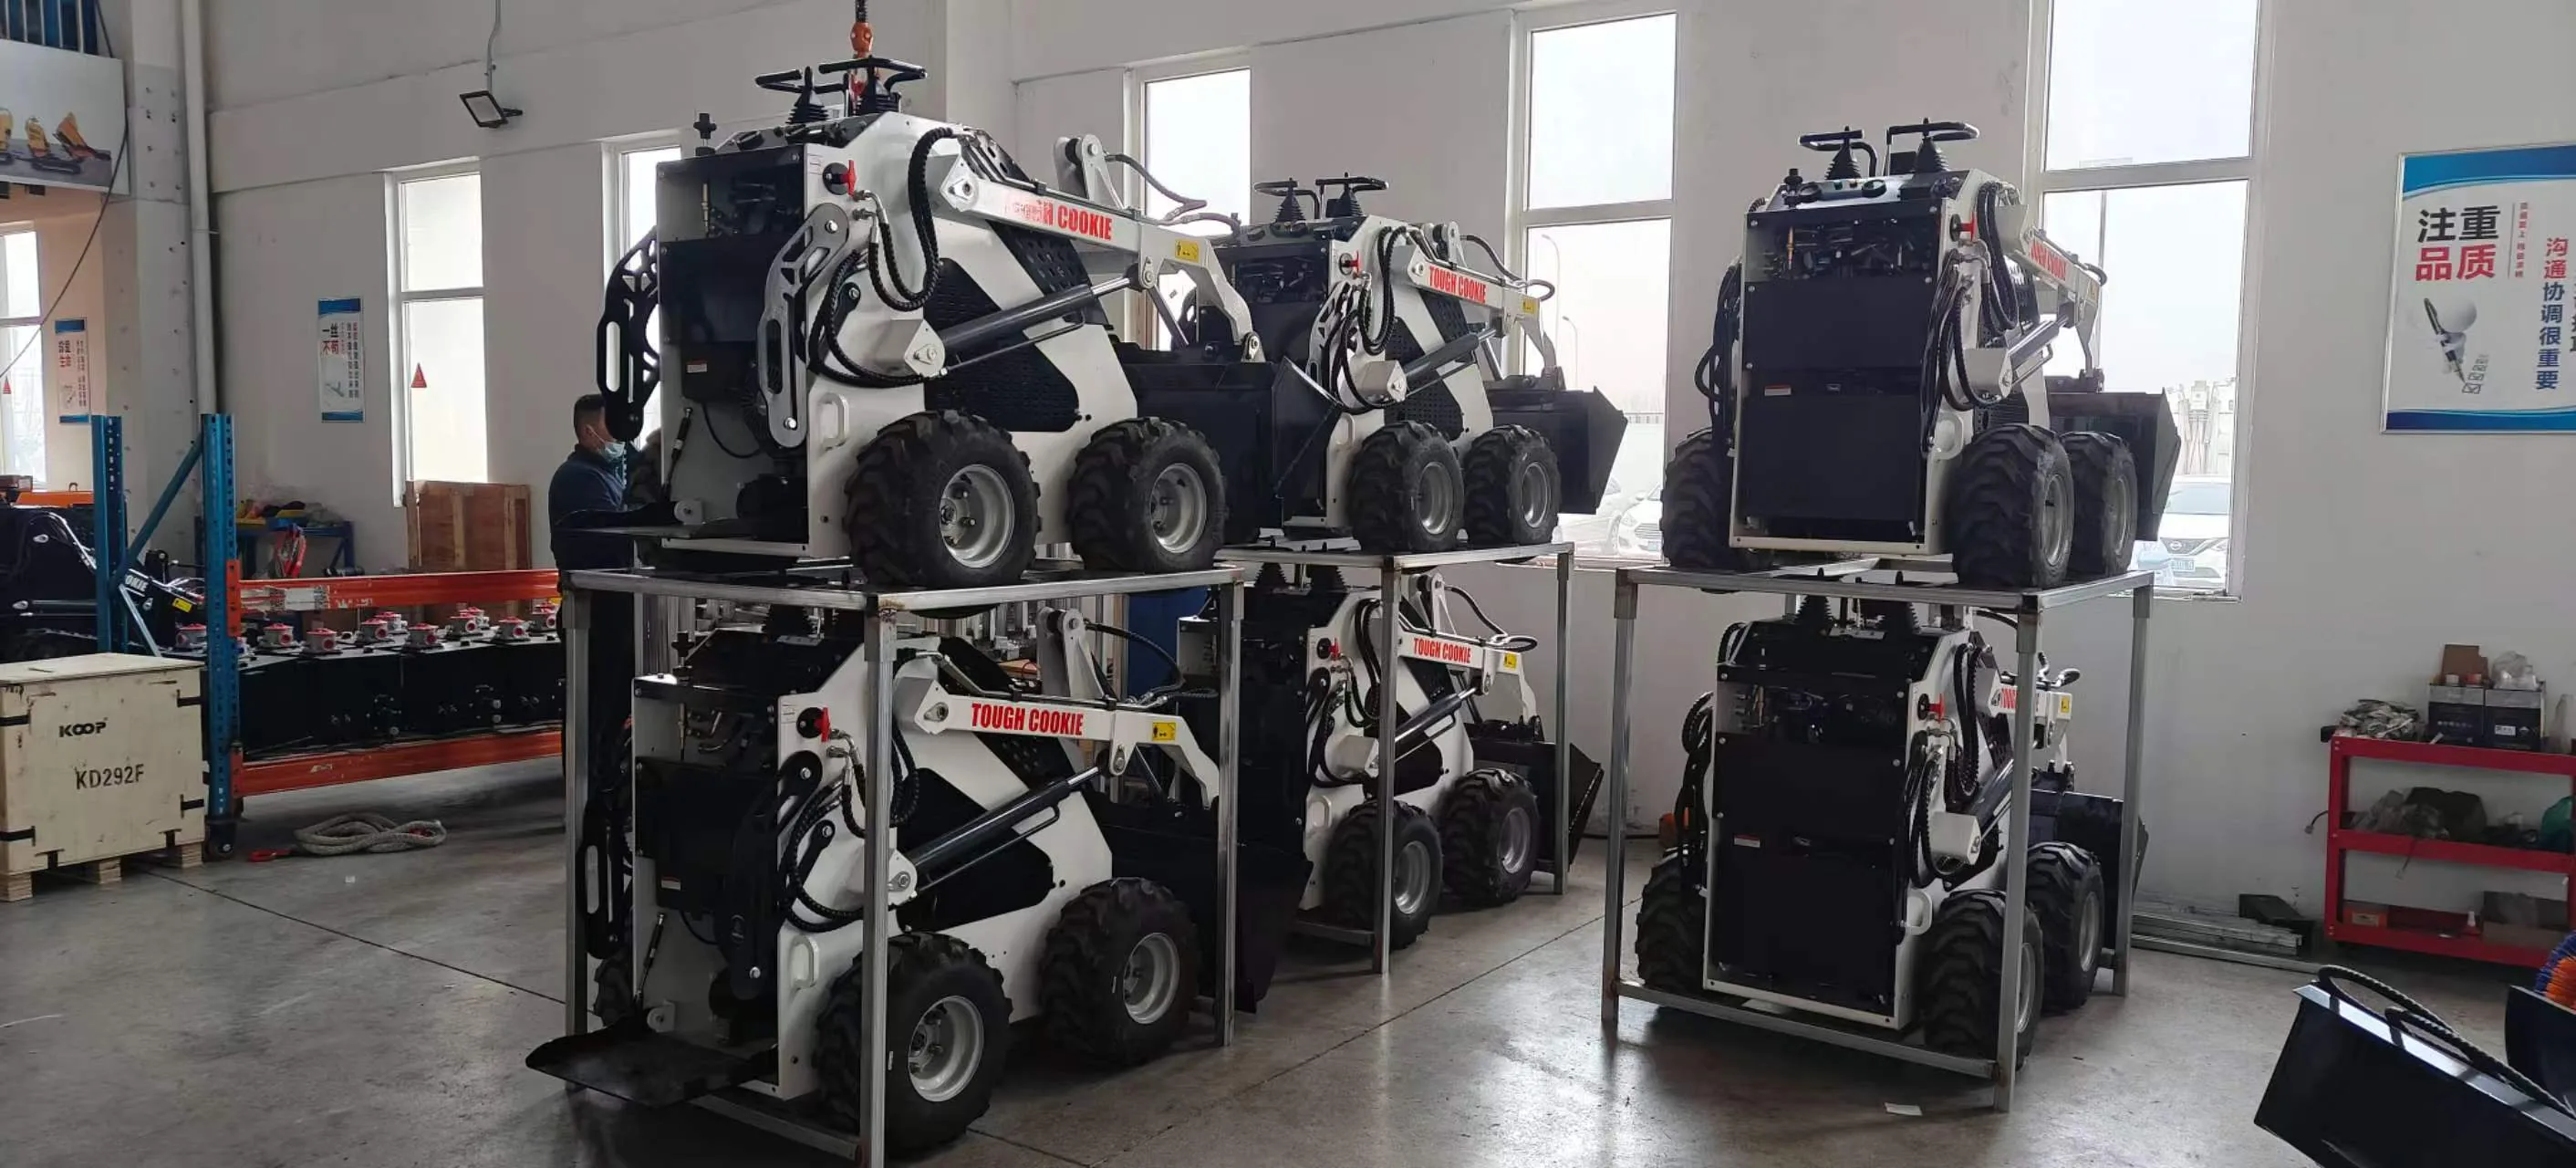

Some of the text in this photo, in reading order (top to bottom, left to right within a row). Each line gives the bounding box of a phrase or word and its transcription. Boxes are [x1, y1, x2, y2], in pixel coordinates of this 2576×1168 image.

[1057, 204, 1112, 240] COOKIE
[2418, 205, 2500, 243] 注重
[2415, 244, 2496, 281] 品质
[1429, 265, 1487, 304] TOUGH COOKIE
[2536, 237, 2568, 391] 沟通协调很重要
[322, 323, 338, 338] 一丝
[321, 339, 339, 354] 不苟
[125, 573, 149, 592] OKIE
[1414, 638, 1471, 664] TOUGH COOKIE
[58, 721, 108, 738] KOOP
[971, 703, 1084, 736] TOUGH COOKIE
[75, 763, 144, 790] KD292F
